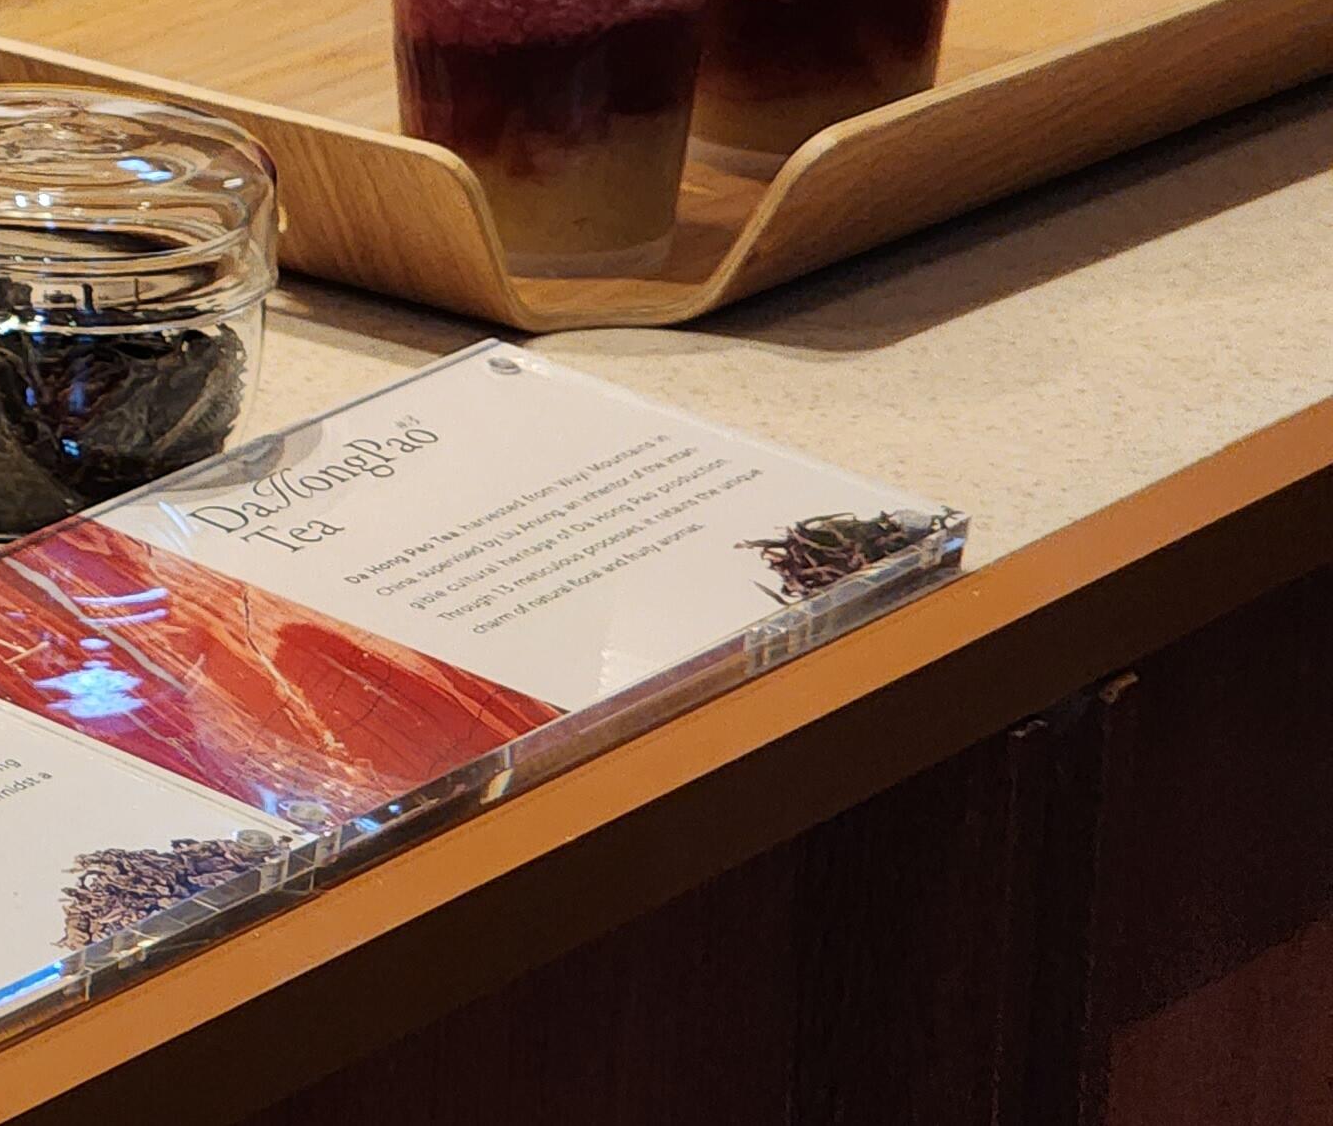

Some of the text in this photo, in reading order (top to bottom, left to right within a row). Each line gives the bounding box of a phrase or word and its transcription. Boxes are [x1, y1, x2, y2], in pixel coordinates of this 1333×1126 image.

[186, 428, 439, 534] DaHongPao
[239, 520, 345, 553] Tea
[38, 772, 53, 780] a
